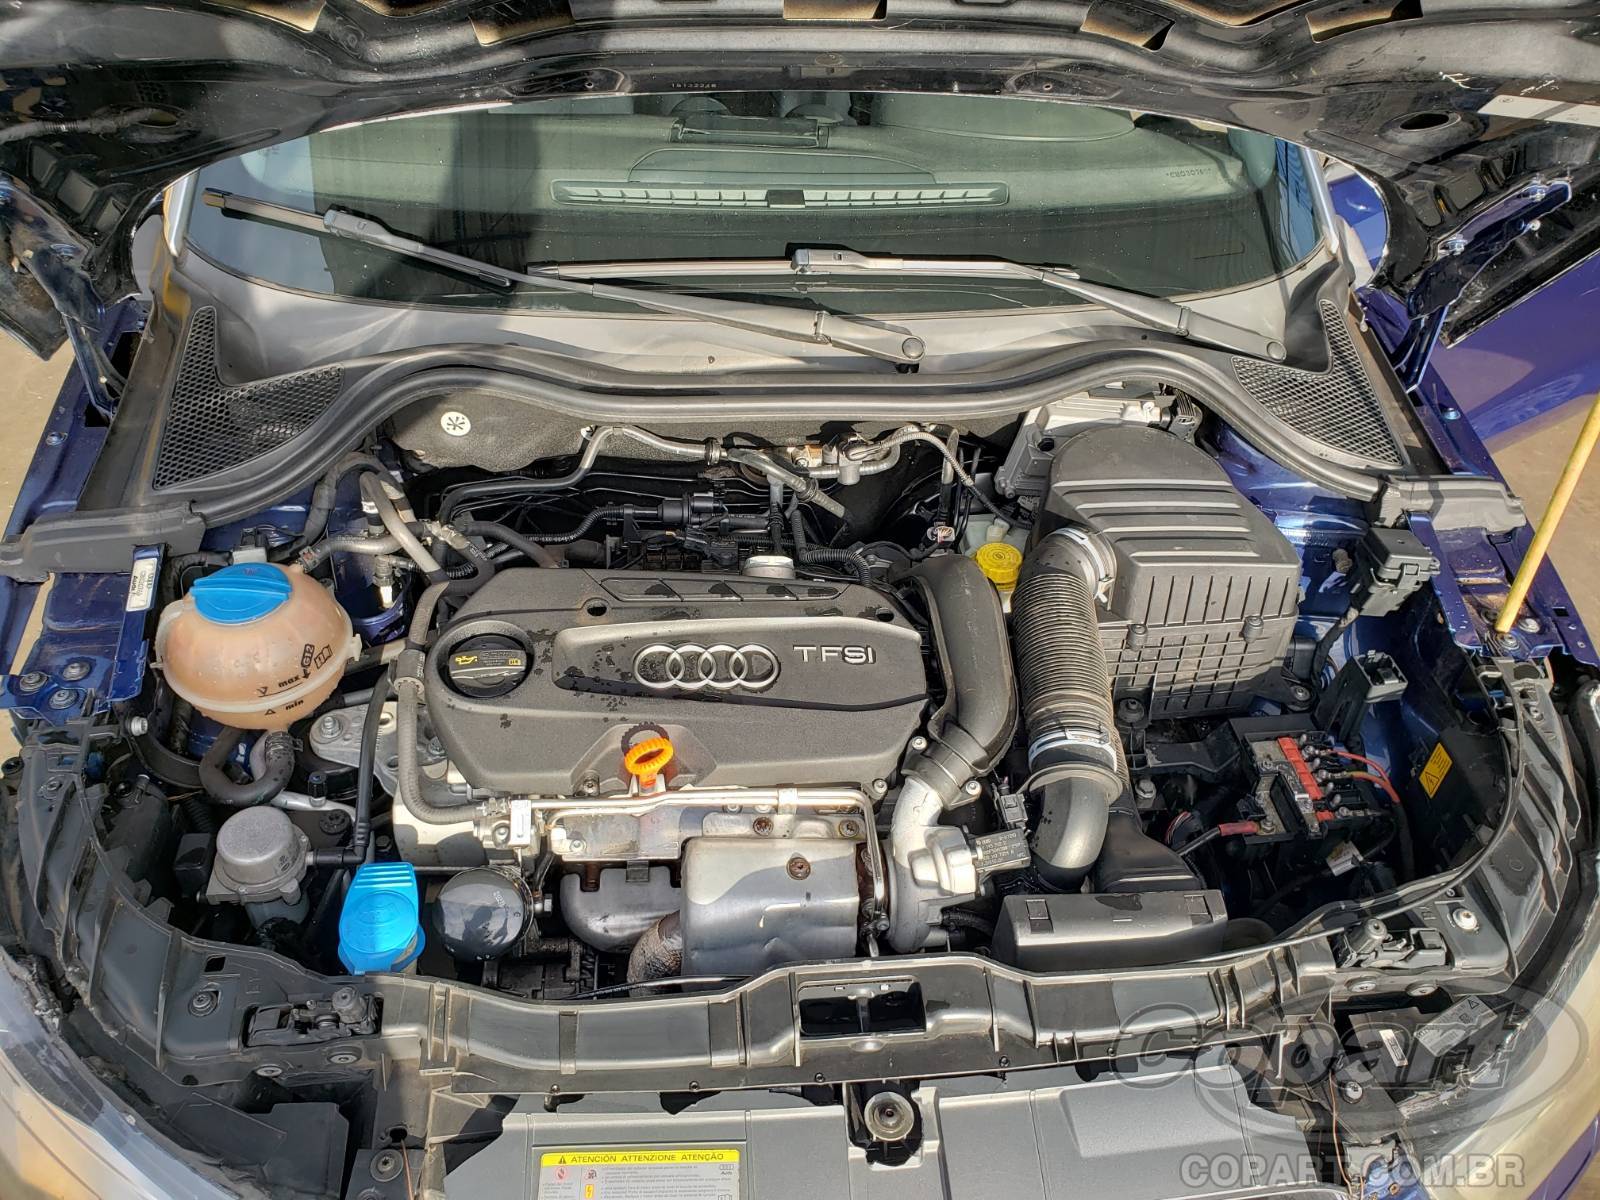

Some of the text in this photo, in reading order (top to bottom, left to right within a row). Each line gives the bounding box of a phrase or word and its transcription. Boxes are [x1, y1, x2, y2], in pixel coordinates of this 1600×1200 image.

[793, 645, 874, 664] TFSI
[278, 675, 301, 688] max
[285, 700, 304, 710] min
[571, 1152, 724, 1163] ATENCIÓN ATTENZIONE ATENÇÃO
